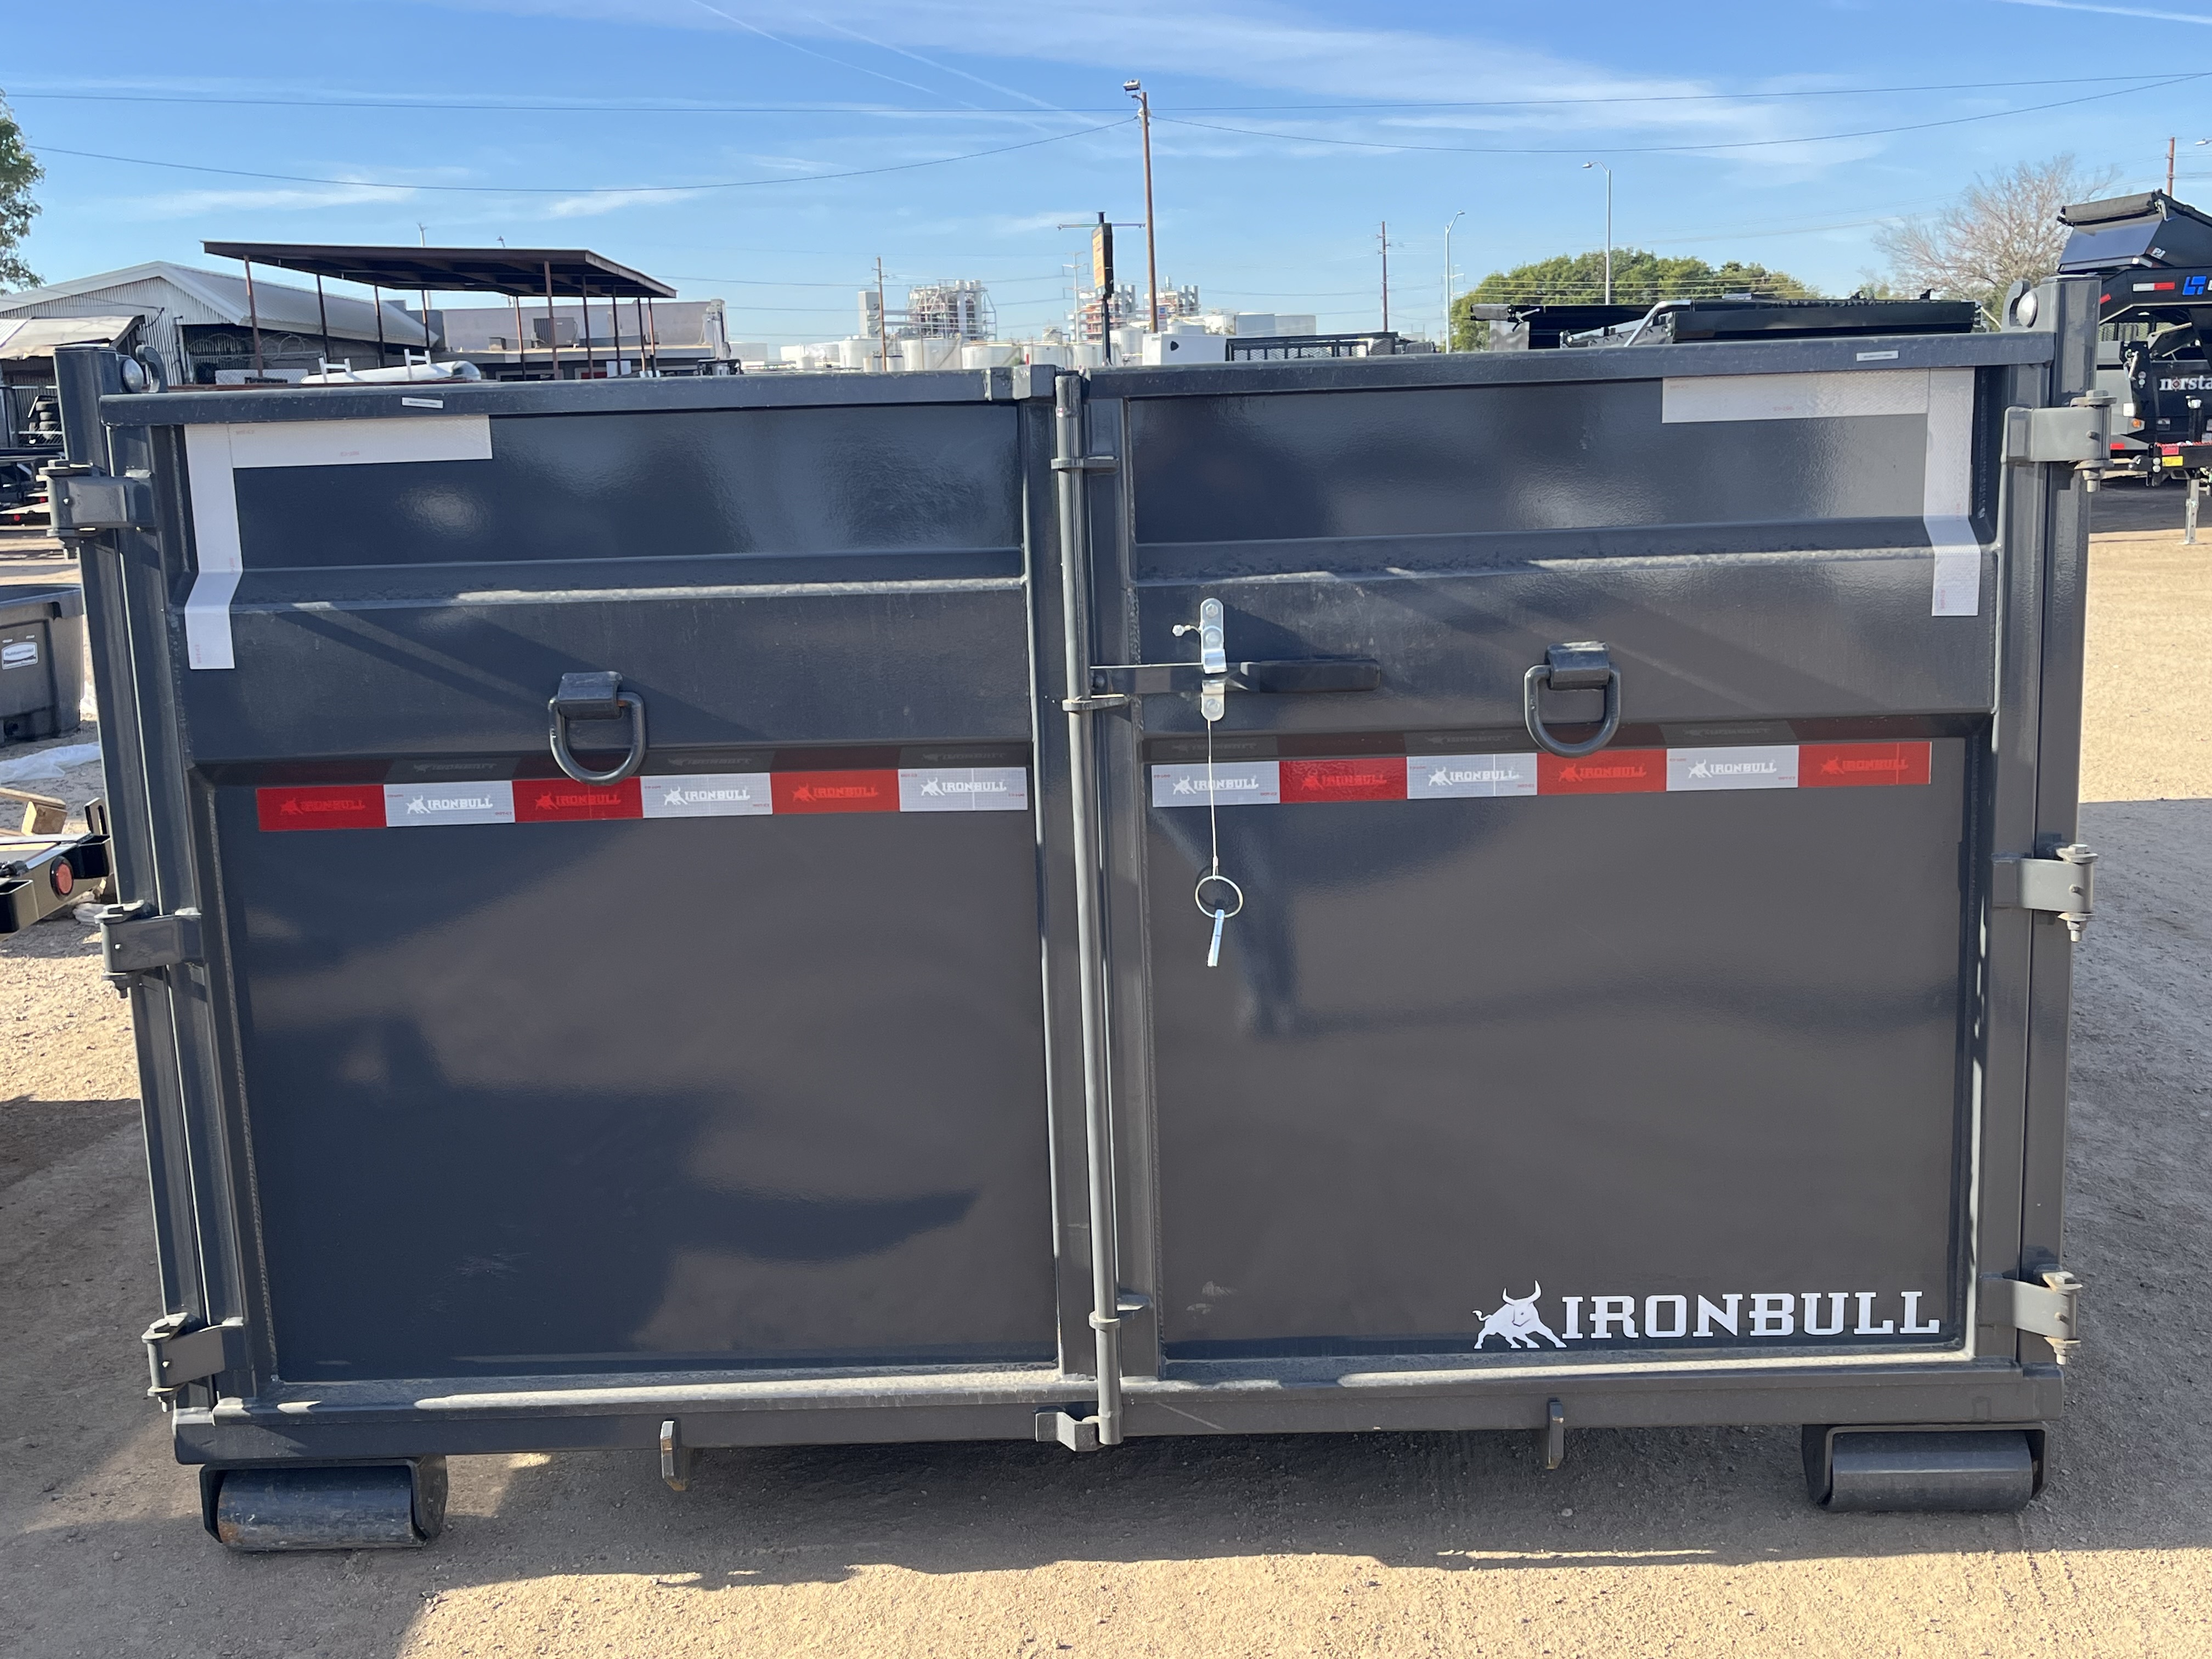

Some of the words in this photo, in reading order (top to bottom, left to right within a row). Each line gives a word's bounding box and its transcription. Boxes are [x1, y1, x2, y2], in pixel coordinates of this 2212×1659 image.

[1711, 761, 1776, 774] IRONBULL
[1450, 769, 1517, 782] IRONBULL
[942, 781, 1007, 793] IRONBULL
[1194, 777, 1259, 791] IRONBULL
[685, 789, 750, 802] IRONBULL
[428, 797, 493, 810] IRONBULL
[1561, 1290, 1940, 1340] IRONBULL
